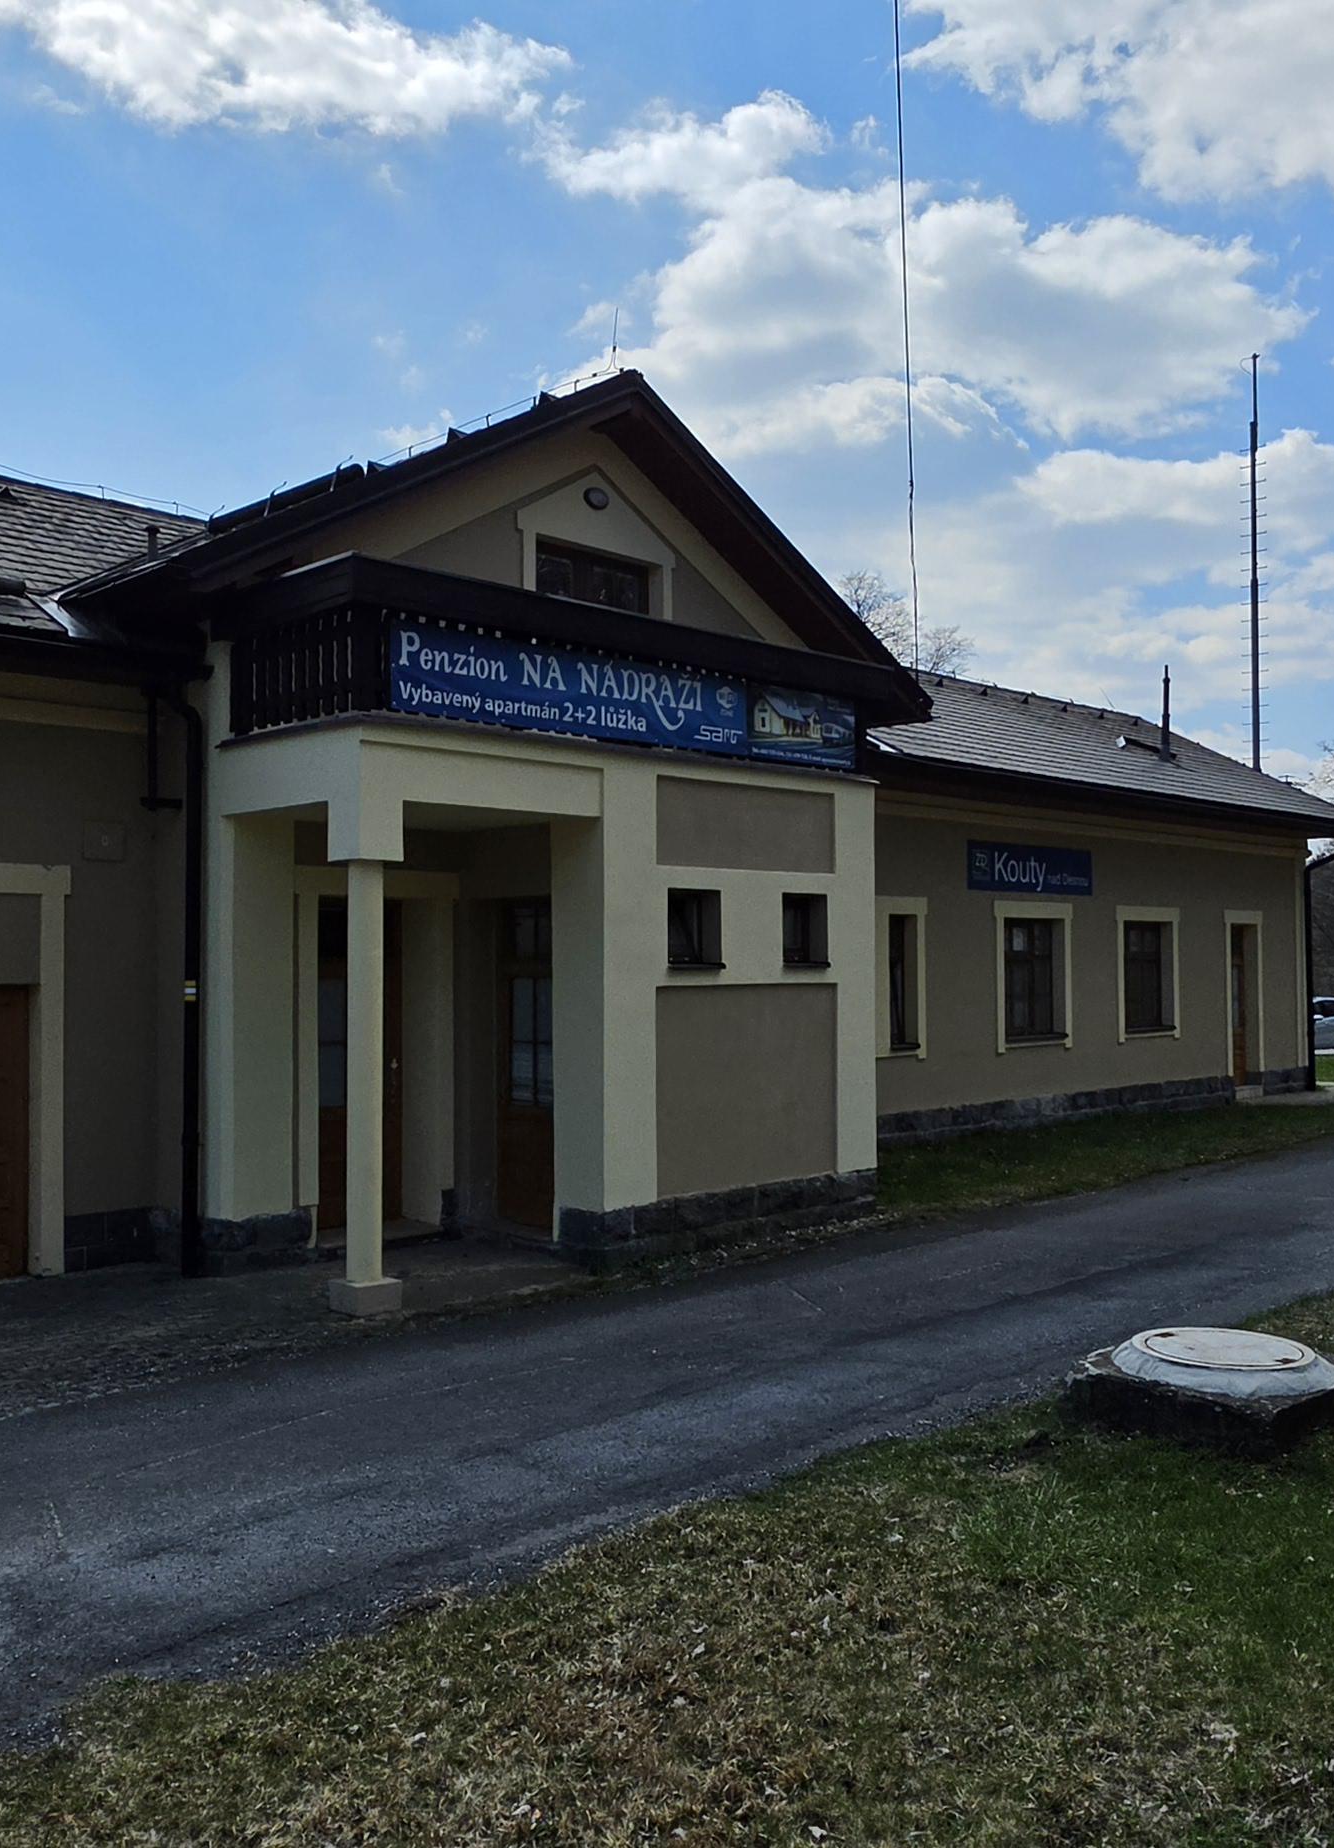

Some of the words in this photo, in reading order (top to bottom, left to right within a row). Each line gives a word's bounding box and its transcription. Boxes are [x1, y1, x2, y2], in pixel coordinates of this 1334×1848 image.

[398, 629, 508, 683] Penzion
[519, 652, 567, 691] NA
[577, 660, 703, 731] NÁDRAŽÍ
[399, 680, 481, 713] Vybavený
[484, 697, 559, 721] apartmán
[562, 702, 597, 725] 2+2
[601, 705, 647, 732] lůžka
[994, 851, 1046, 892] Kouty
